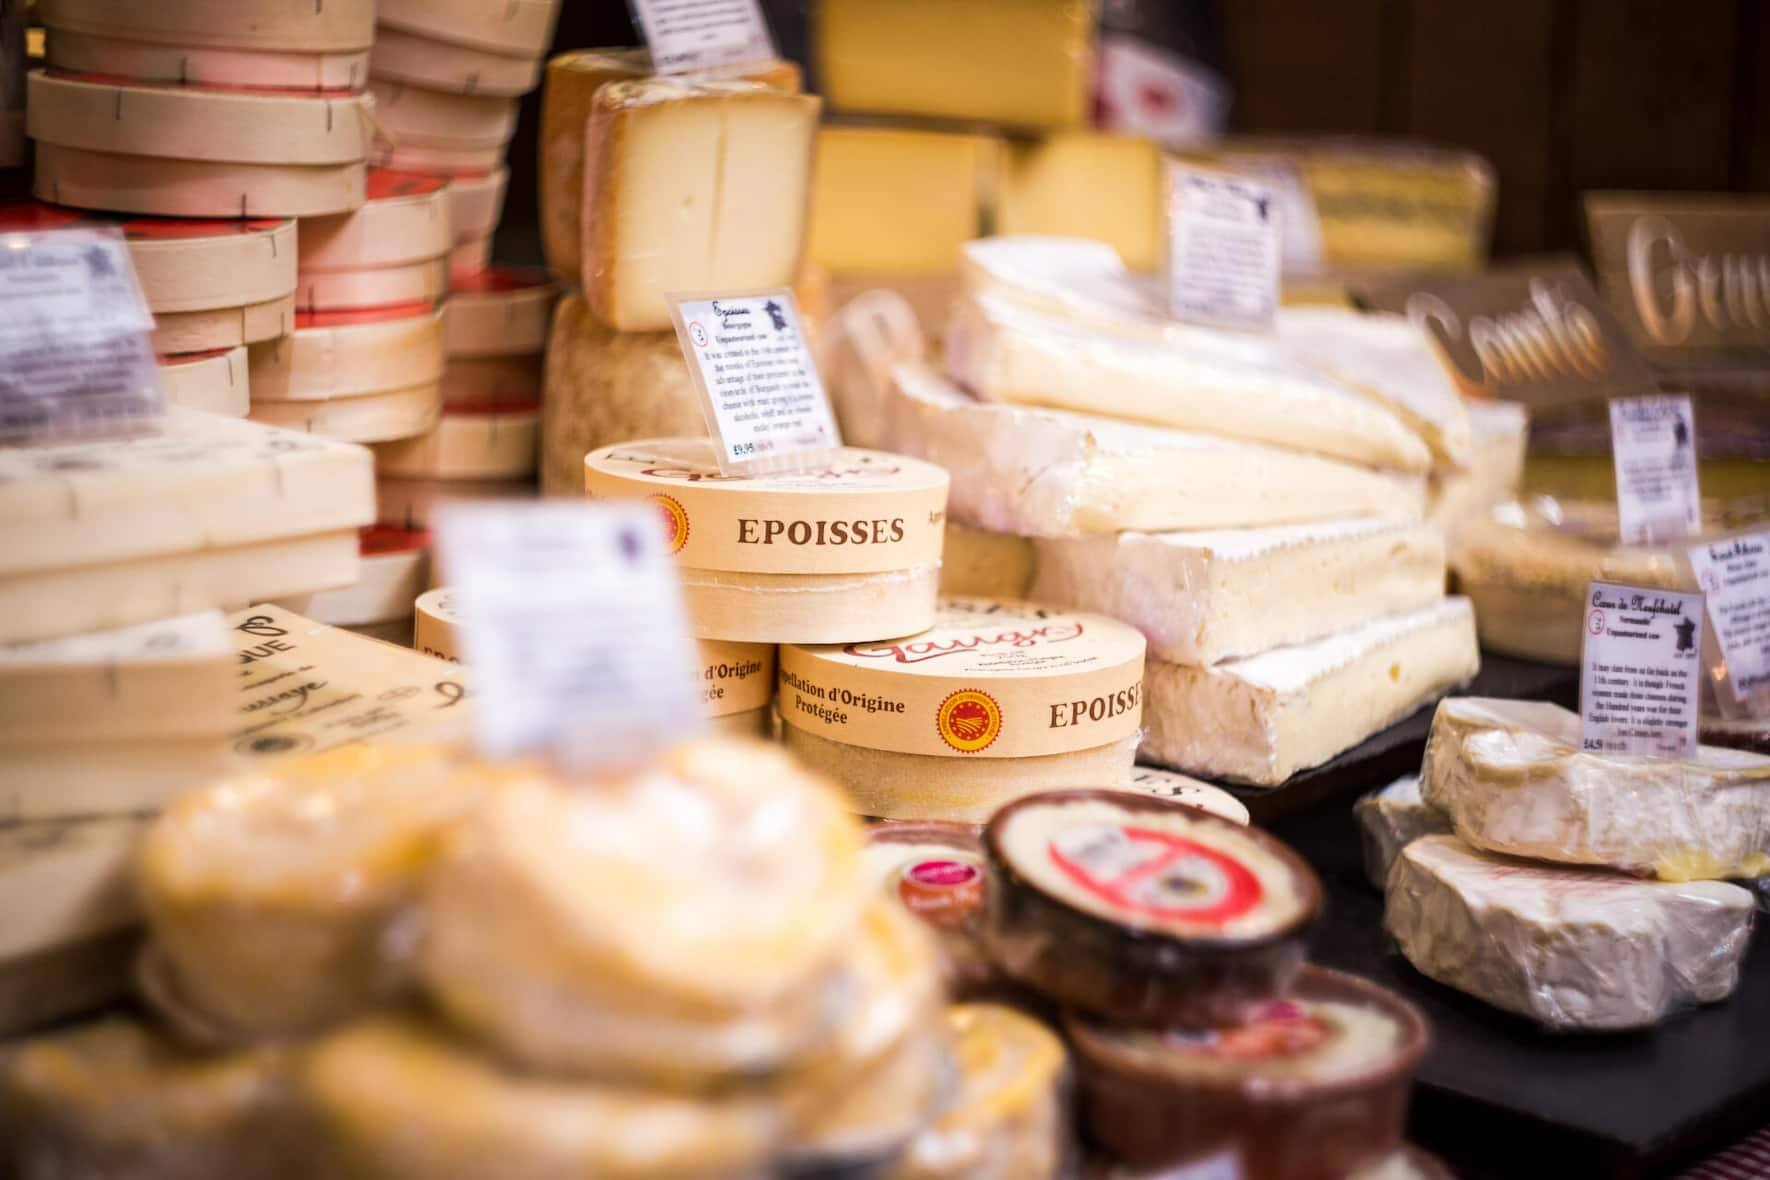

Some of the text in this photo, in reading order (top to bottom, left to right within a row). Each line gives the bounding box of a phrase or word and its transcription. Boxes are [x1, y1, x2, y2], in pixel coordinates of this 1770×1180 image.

[737, 518, 904, 545] EPOISSES
[704, 660, 762, 680] d'Origine
[795, 694, 848, 724] Protégée
[829, 687, 905, 713] d'Origine
